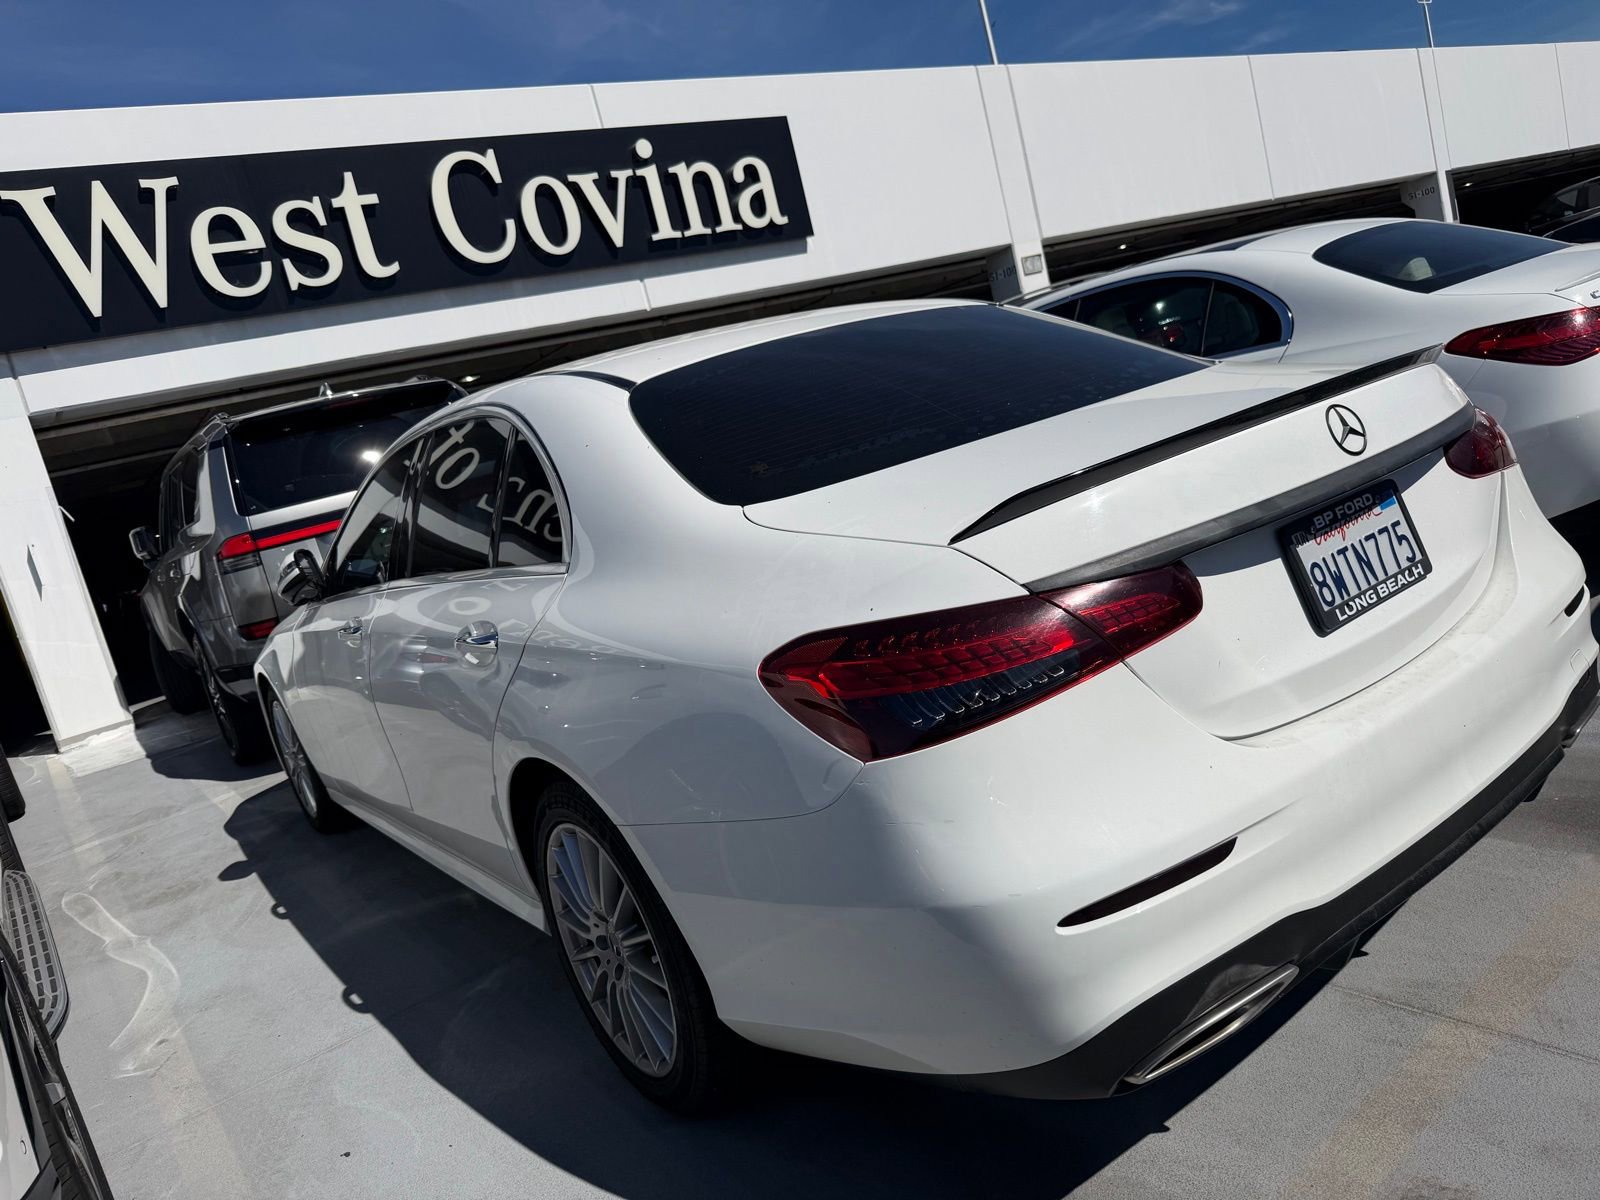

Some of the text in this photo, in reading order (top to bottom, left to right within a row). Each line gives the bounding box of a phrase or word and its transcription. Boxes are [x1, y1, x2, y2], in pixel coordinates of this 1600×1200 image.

[1, 137, 788, 318] West Covina
[1313, 493, 1373, 529] BP FORD
[1309, 518, 1417, 608] 8WTN775
[1335, 563, 1424, 621] LONG BEACH
